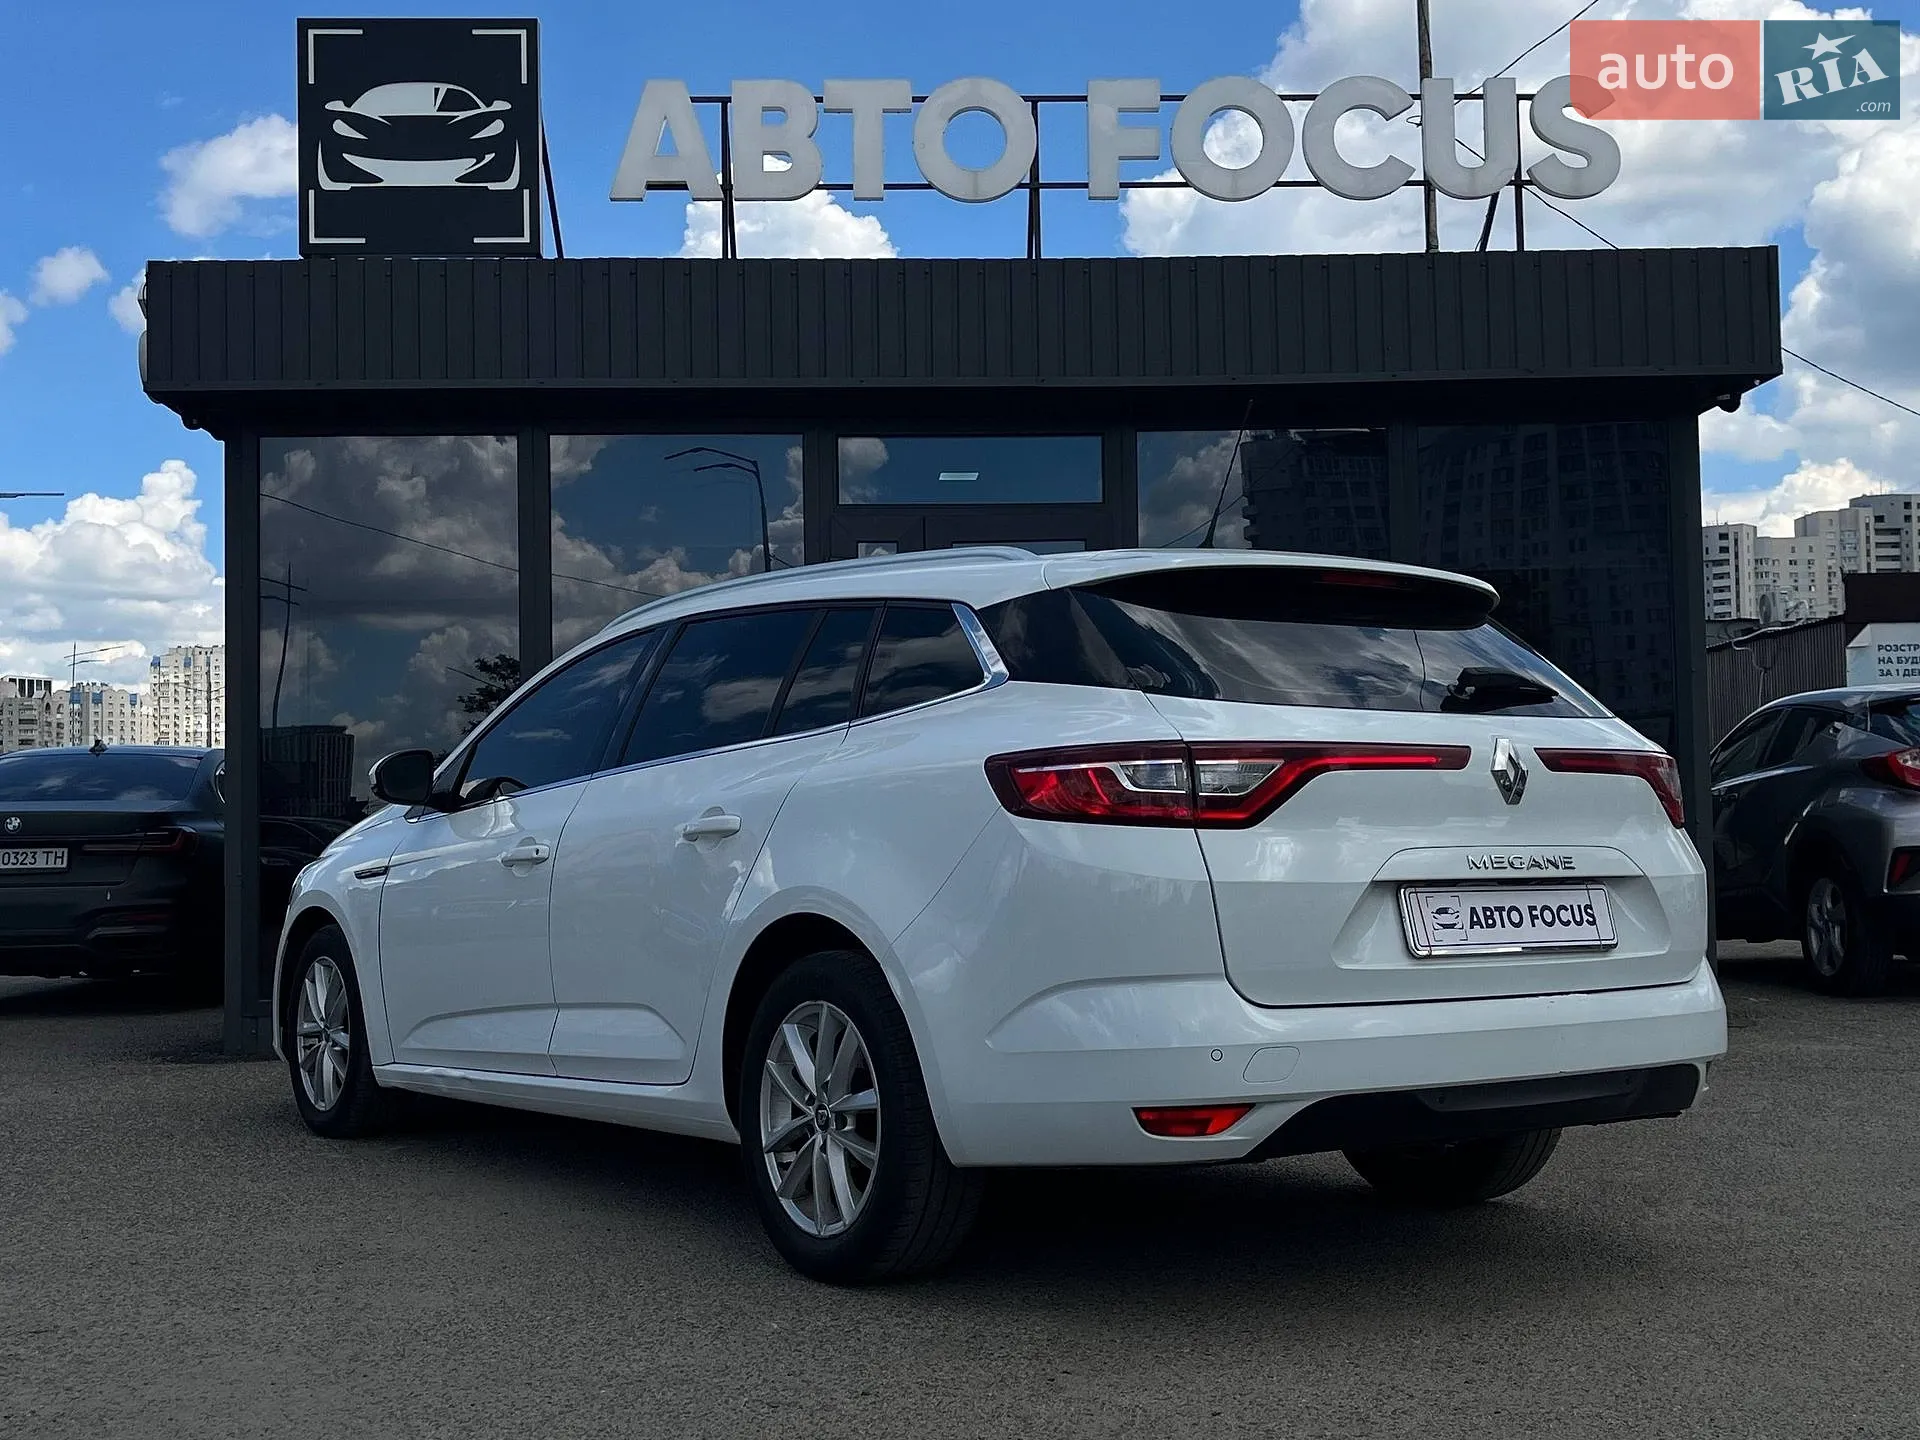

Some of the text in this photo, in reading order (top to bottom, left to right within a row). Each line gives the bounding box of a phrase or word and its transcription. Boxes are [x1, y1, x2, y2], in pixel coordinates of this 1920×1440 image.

[609, 75, 1622, 203] АВТО FOCUS
[1878, 656, 1894, 665] НА
[1878, 668, 1893, 677] ЗА
[1895, 668, 1900, 677] 1
[2, 850, 65, 866] 0323 TH
[1466, 854, 1576, 871] MEGANE
[1468, 903, 1597, 930] АВТО FOCUS
